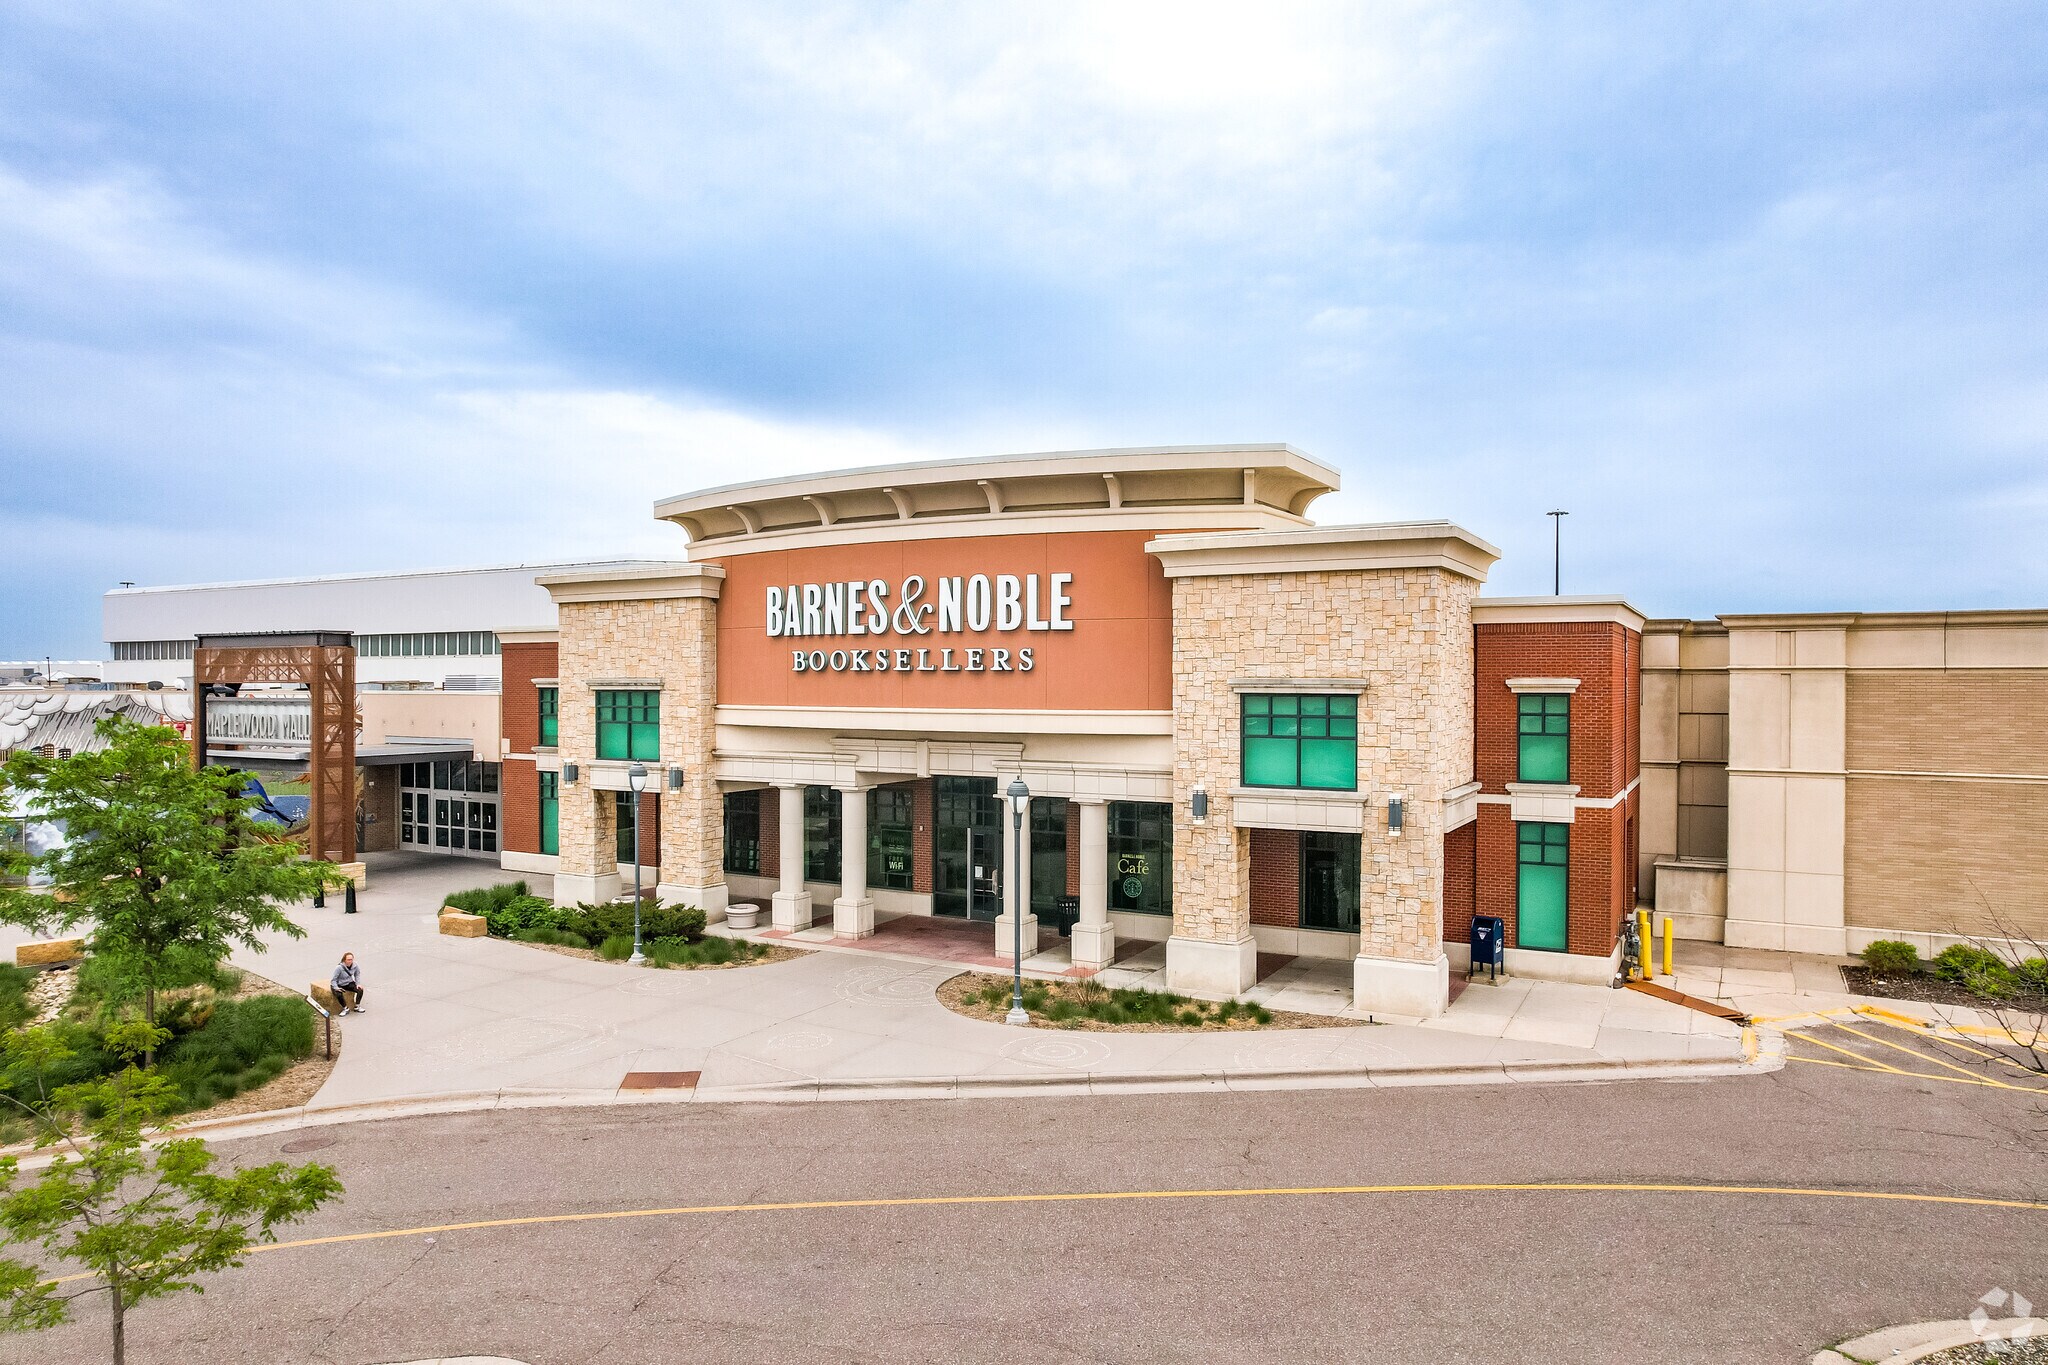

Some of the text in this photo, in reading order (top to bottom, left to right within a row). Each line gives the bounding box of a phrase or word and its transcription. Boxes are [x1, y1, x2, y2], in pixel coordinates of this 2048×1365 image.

[766, 572, 1075, 636] BARNES & NOBLE
[791, 647, 1036, 672] BOOKSELLERS
[206, 712, 311, 739] MAPLEWOOD MALL
[441, 811, 444, 819] 1
[457, 812, 460, 820] 1
[488, 815, 491, 823] 1
[1117, 858, 1150, 875] Café
